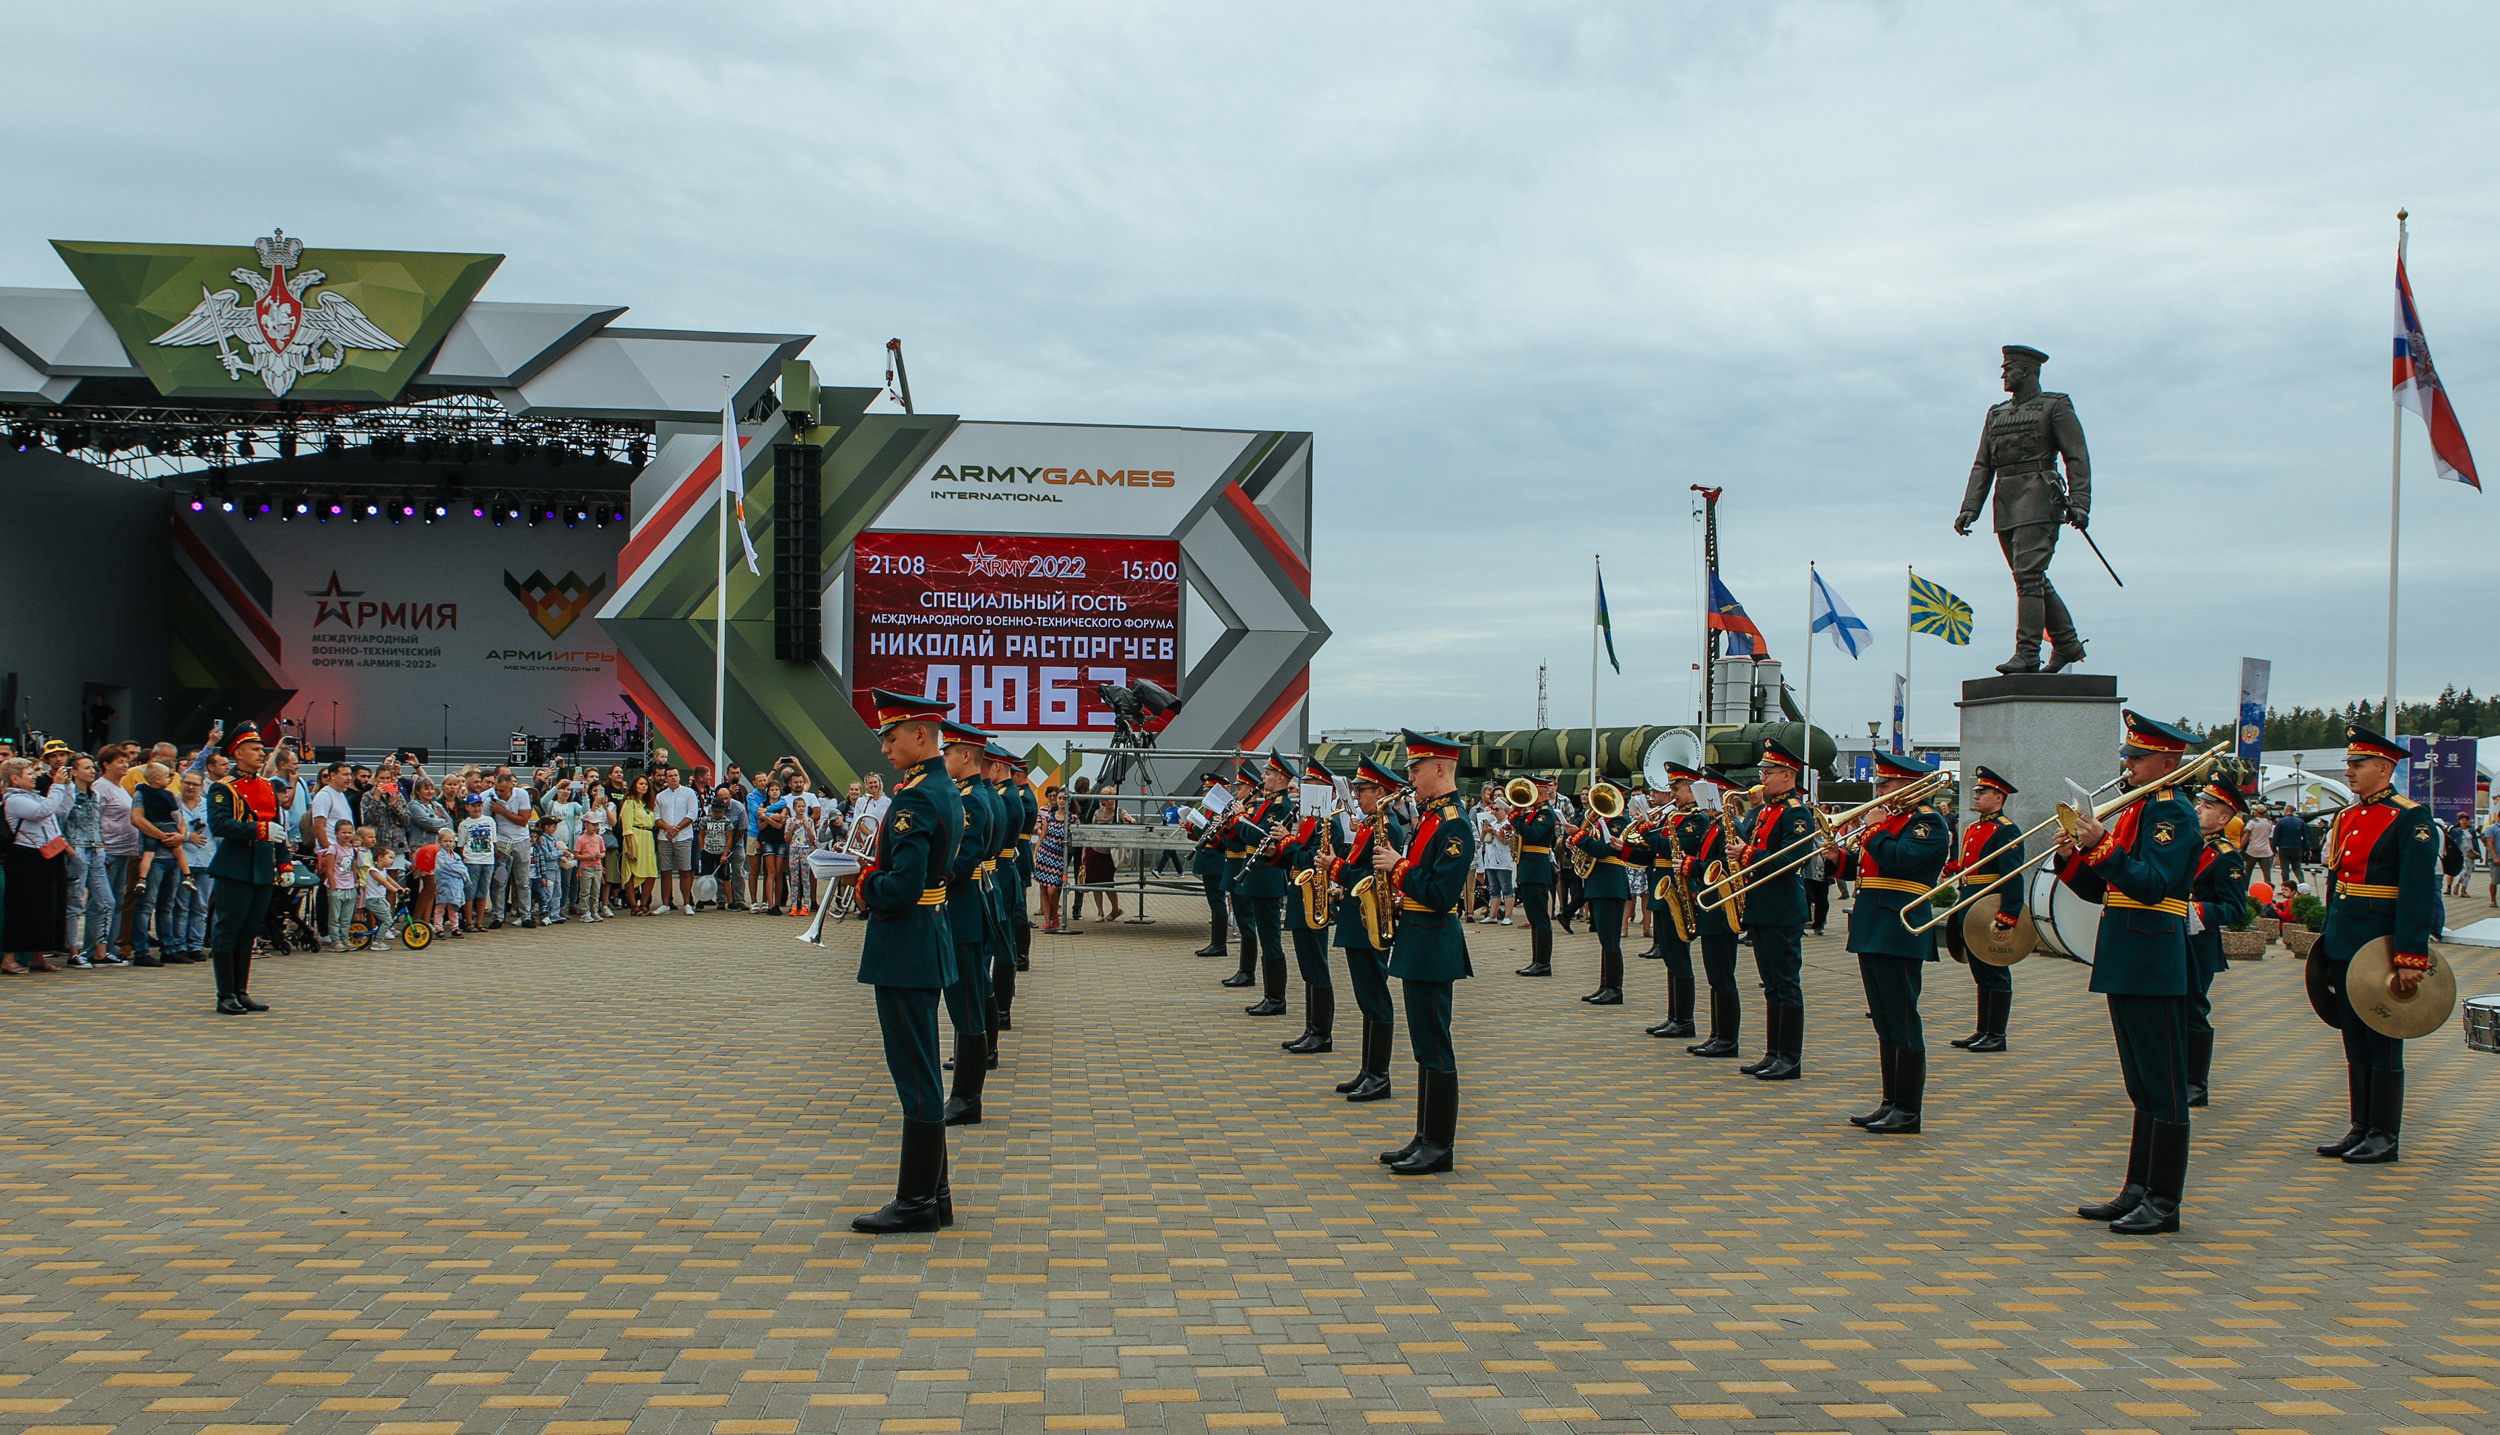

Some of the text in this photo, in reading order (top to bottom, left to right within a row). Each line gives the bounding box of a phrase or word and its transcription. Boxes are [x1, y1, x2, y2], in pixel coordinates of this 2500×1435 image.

[930, 464, 1176, 488] ARMYGAMES
[930, 491, 1063, 502] INTERNATIONAL
[868, 555, 925, 575] 21.08
[1121, 560, 1177, 581] 15:00
[303, 568, 457, 631] АРМИЯ
[920, 590, 1127, 611] СПЕЦИАЛЬНЫЙ ГОСТЬ
[871, 613, 1174, 629] МЕЖДУНАРОДНОГО ВОЕННО-ТЕХНИЧЕСКОГО ФОРУМА
[312, 634, 418, 645] МЕЖДУНАРОДНЫЙ
[870, 629, 1174, 660] НИКОЛАЙ РАСТОРГУЕВ
[312, 646, 441, 657] ВОЕННО-ТЕХНИЧЕСКИЙ
[312, 658, 437, 668] ФОРУМ «АРМИЯ-2022»
[706, 822, 726, 831] WEST
